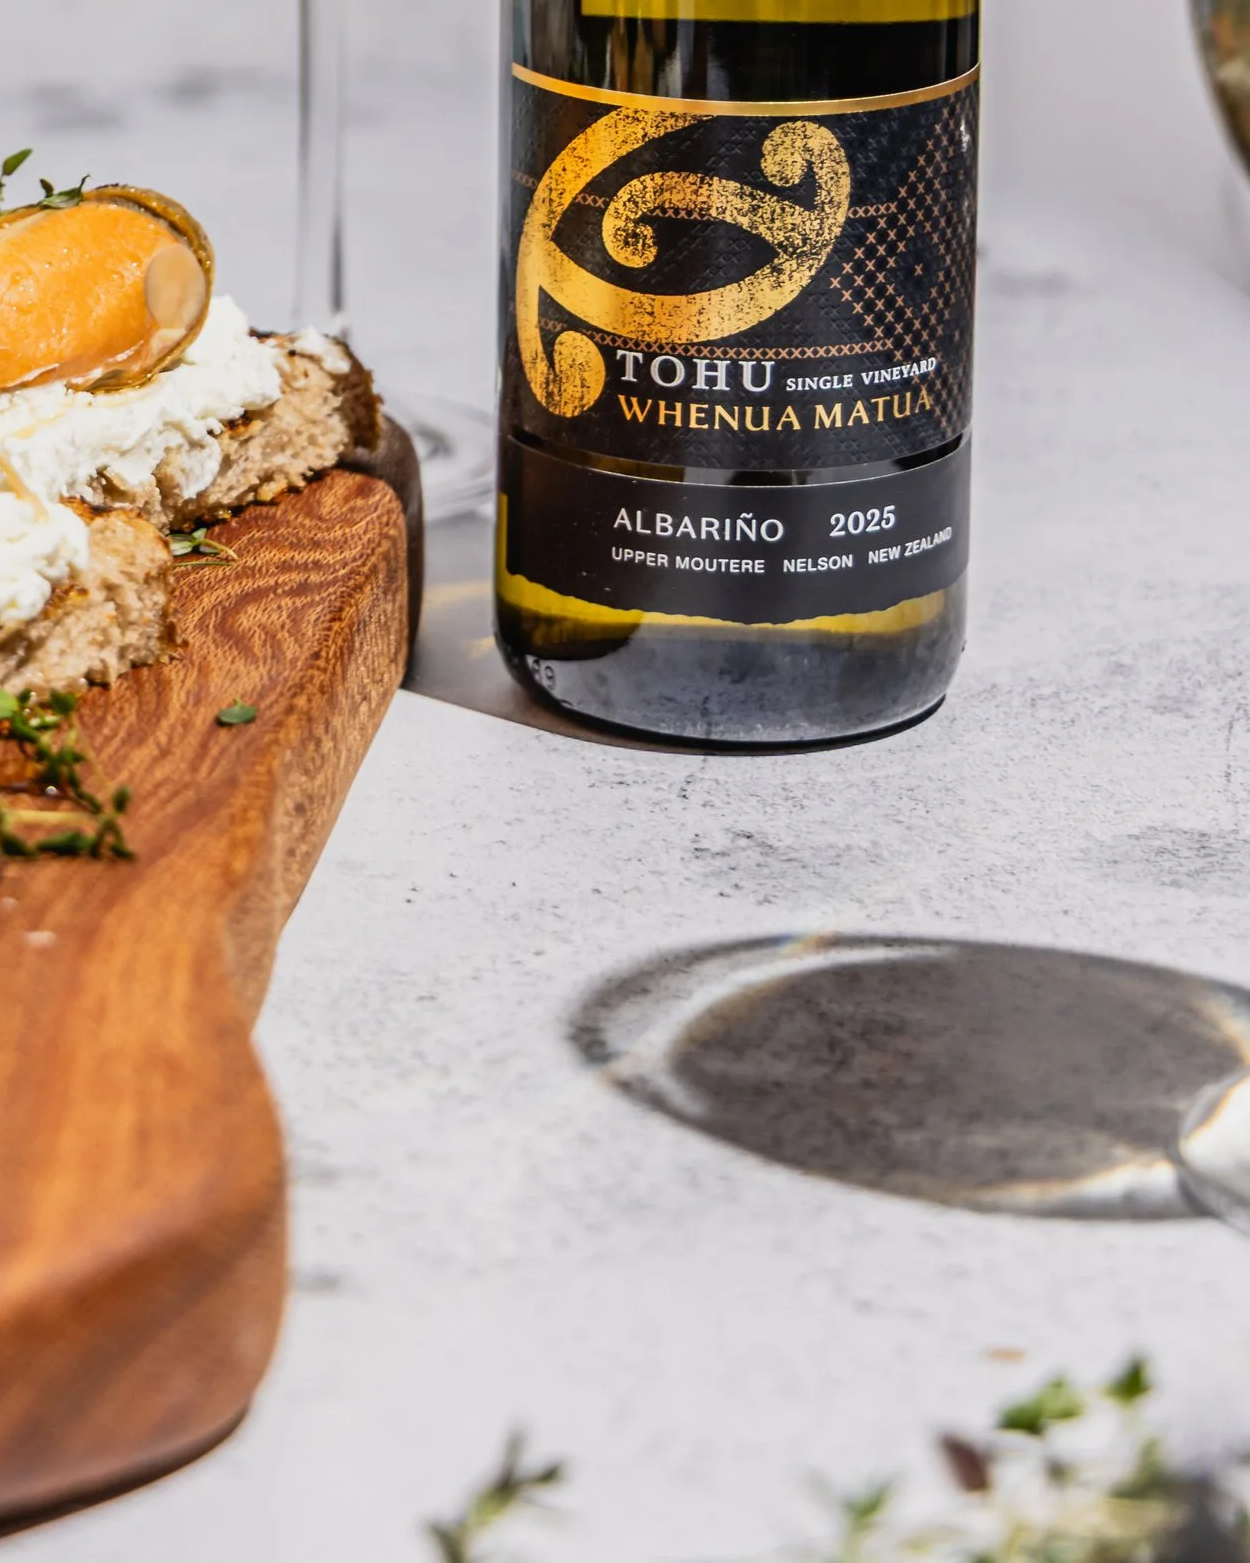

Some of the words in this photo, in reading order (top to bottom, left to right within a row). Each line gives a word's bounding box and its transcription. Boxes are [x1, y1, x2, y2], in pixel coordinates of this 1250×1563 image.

[616, 349, 775, 392] TOHU
[785, 374, 853, 391] SINGLE
[860, 357, 936, 385] VINEYARD
[617, 394, 801, 431] WHENUA
[814, 386, 931, 429] MATUA
[613, 507, 784, 542] ALBARIÑO
[829, 505, 896, 537] 2025
[611, 546, 669, 568] UPPER
[675, 555, 765, 573] MOUTERE
[783, 554, 853, 572] NELSON
[868, 545, 901, 564] NEW
[904, 526, 953, 557] ZEALAND
